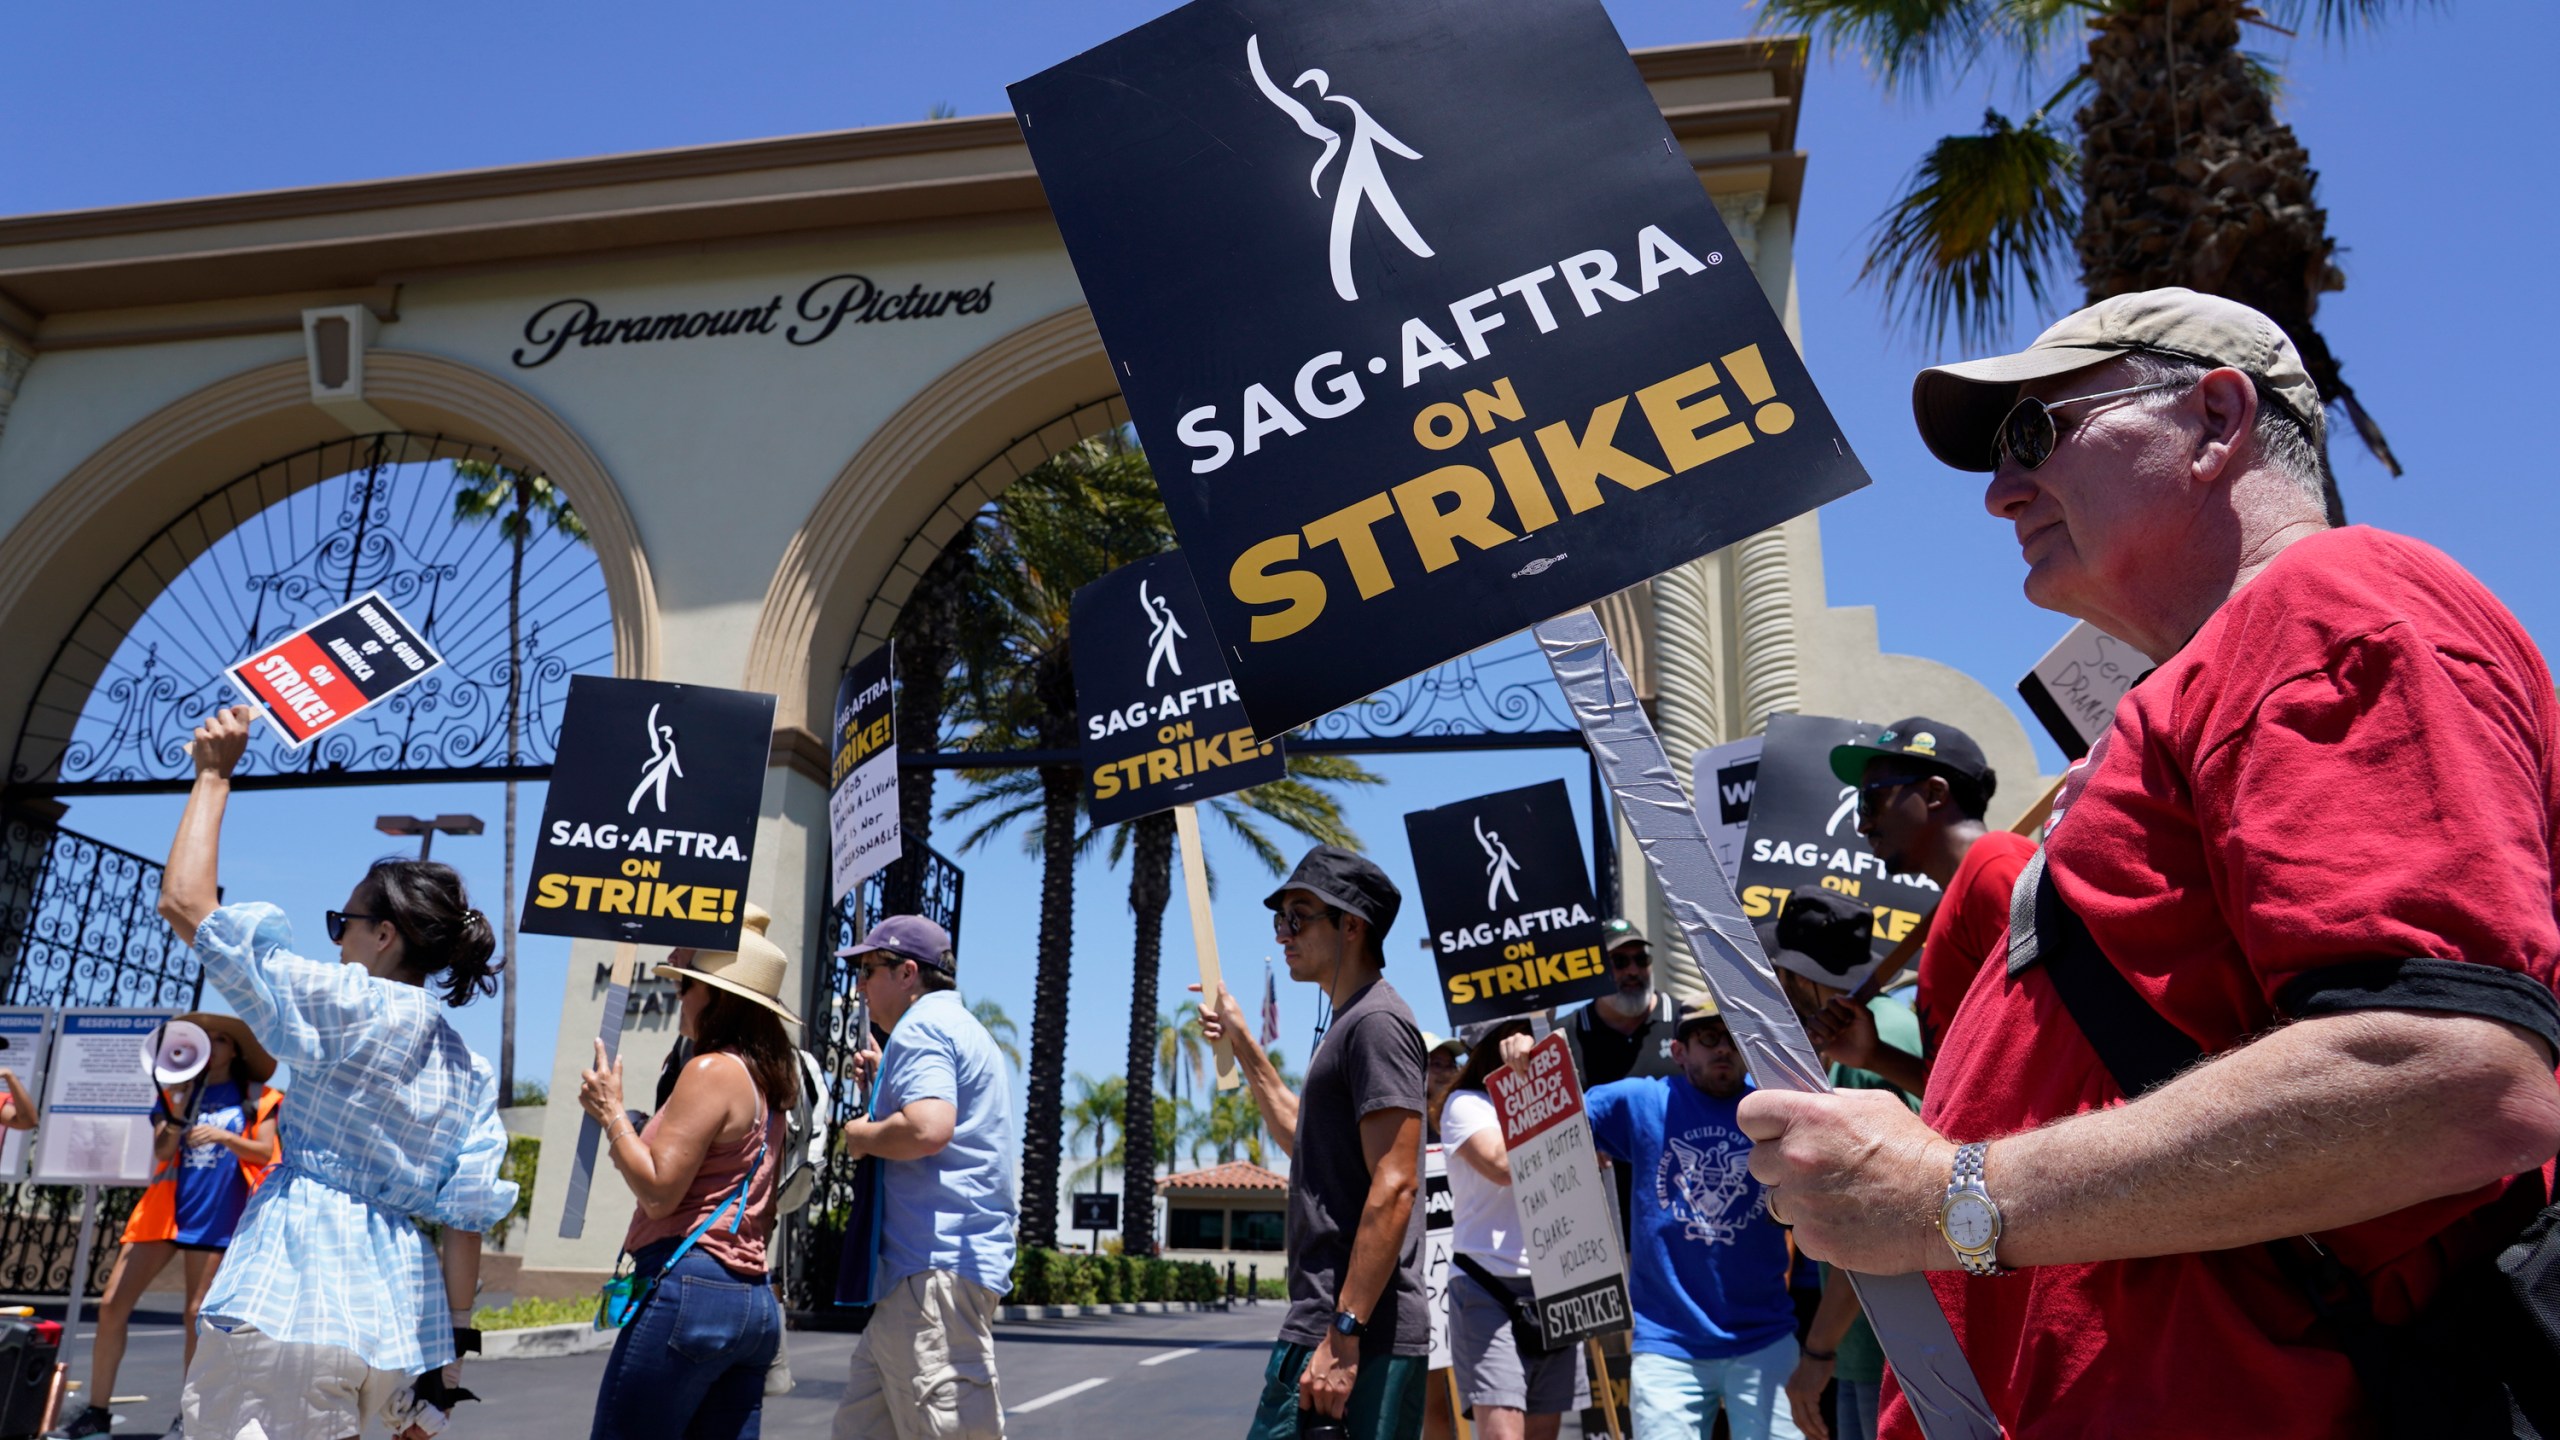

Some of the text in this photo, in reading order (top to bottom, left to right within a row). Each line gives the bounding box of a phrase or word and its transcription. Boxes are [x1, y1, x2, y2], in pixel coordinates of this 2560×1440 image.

[512, 274, 995, 369] Paramount Pictures
[1413, 376, 1527, 451] ON
[1229, 343, 1796, 642] STRIKE!
[328, 637, 375, 682] AMERICA
[357, 604, 425, 672] WRITERS GUILD
[361, 640, 383, 655] OF
[255, 654, 337, 728] STRIKE!
[308, 664, 336, 687] ON
[845, 718, 858, 740] ON
[1088, 678, 1240, 740] SAG·AFTR
[1157, 721, 1194, 744] ON
[832, 713, 891, 789] STRIKE!
[857, 795, 862, 809] A
[865, 775, 897, 803] LIVING
[850, 827, 857, 840] IS
[861, 812, 884, 831] NOT
[620, 858, 661, 879] ON
[836, 822, 899, 884] UNREASONABLE
[534, 873, 738, 924] STRIKE!
[1820, 875, 1861, 897] ON
[1448, 946, 1605, 1004] STRIKE!
[1503, 941, 1535, 961] ON
[77, 1018, 162, 1029] RESERVED GATE
[1504, 1071, 1562, 1116] GUILD OF
[1508, 1086, 1573, 1140] AMERICA
[1684, 1125, 1748, 1146] GUILD OF
[1522, 1165, 1582, 1218] THAN YOUR
[1656, 1150, 1674, 1210] WRITERS
[1560, 1238, 1608, 1278] HOLDERS
[1546, 1285, 1625, 1338] STRIKE
